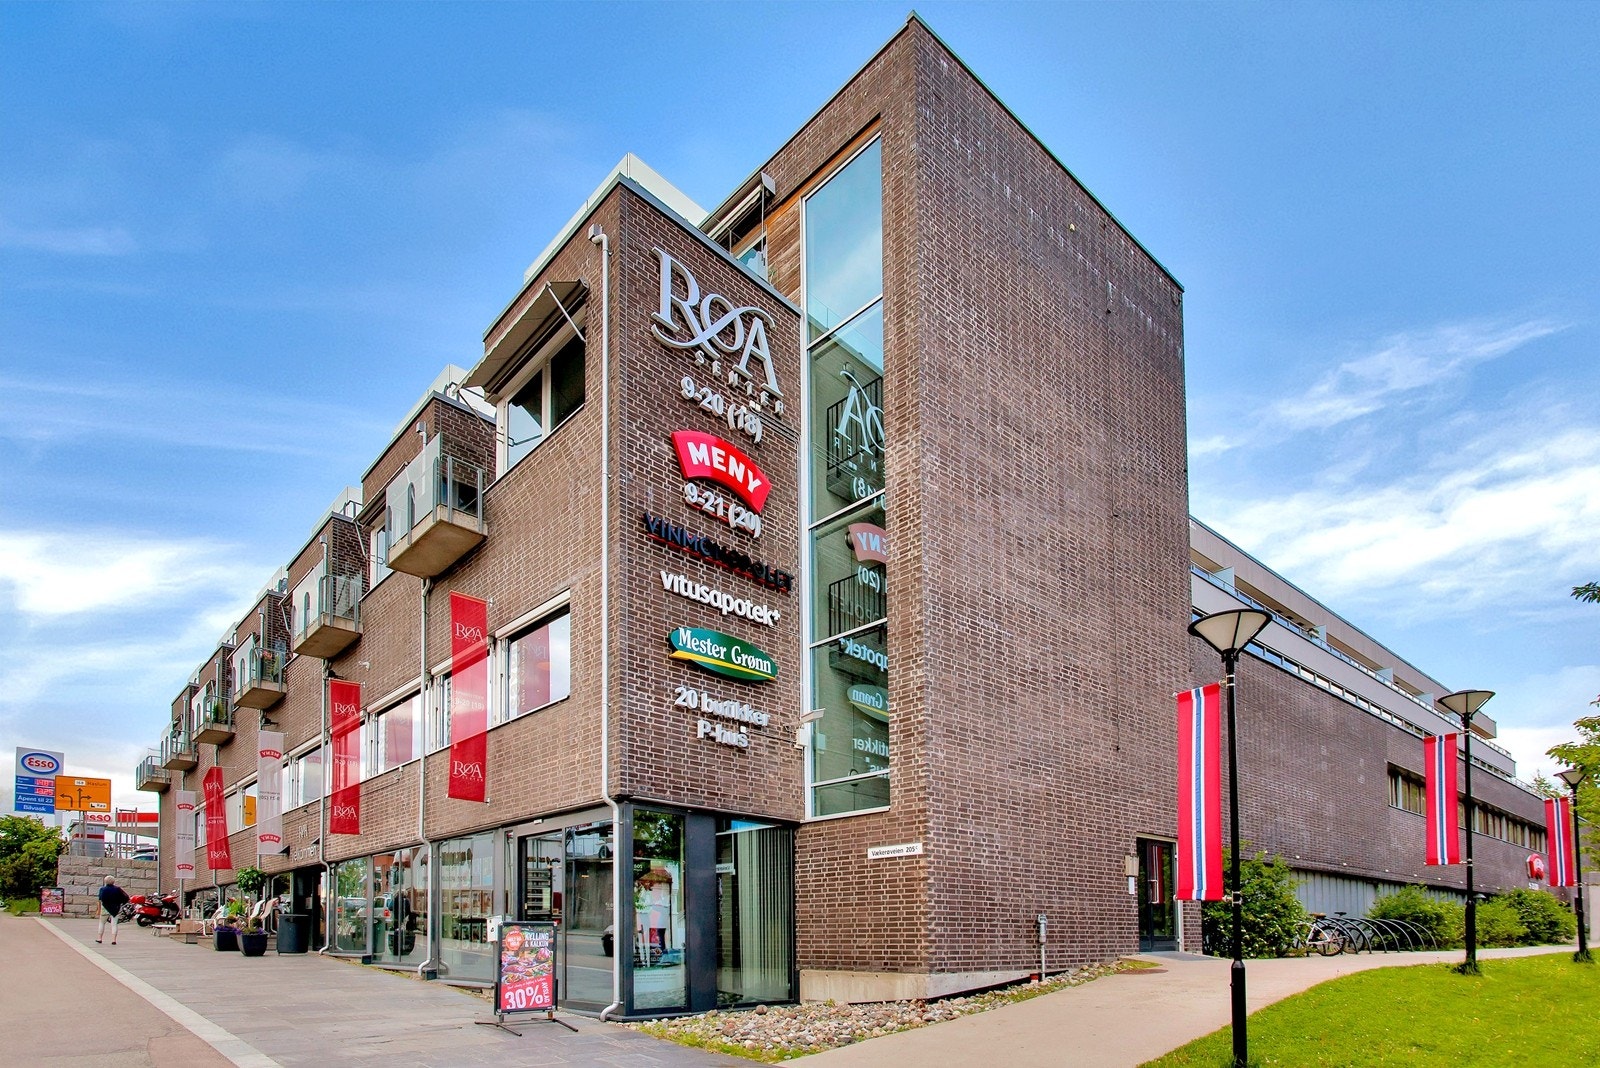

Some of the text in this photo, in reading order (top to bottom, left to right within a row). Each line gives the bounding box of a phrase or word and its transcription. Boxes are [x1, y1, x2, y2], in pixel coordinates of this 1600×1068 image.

[694, 350, 785, 416] SENTER
[680, 376, 762, 444] 9-20 (18)
[687, 441, 762, 494] MENY
[684, 482, 761, 538] 9-21 (20)
[678, 627, 772, 674] Mester Grønn
[674, 686, 770, 728] 20 butikker
[697, 719, 749, 749] P-hus
[27, 757, 55, 769] Esso
[504, 985, 544, 1010] 30%
